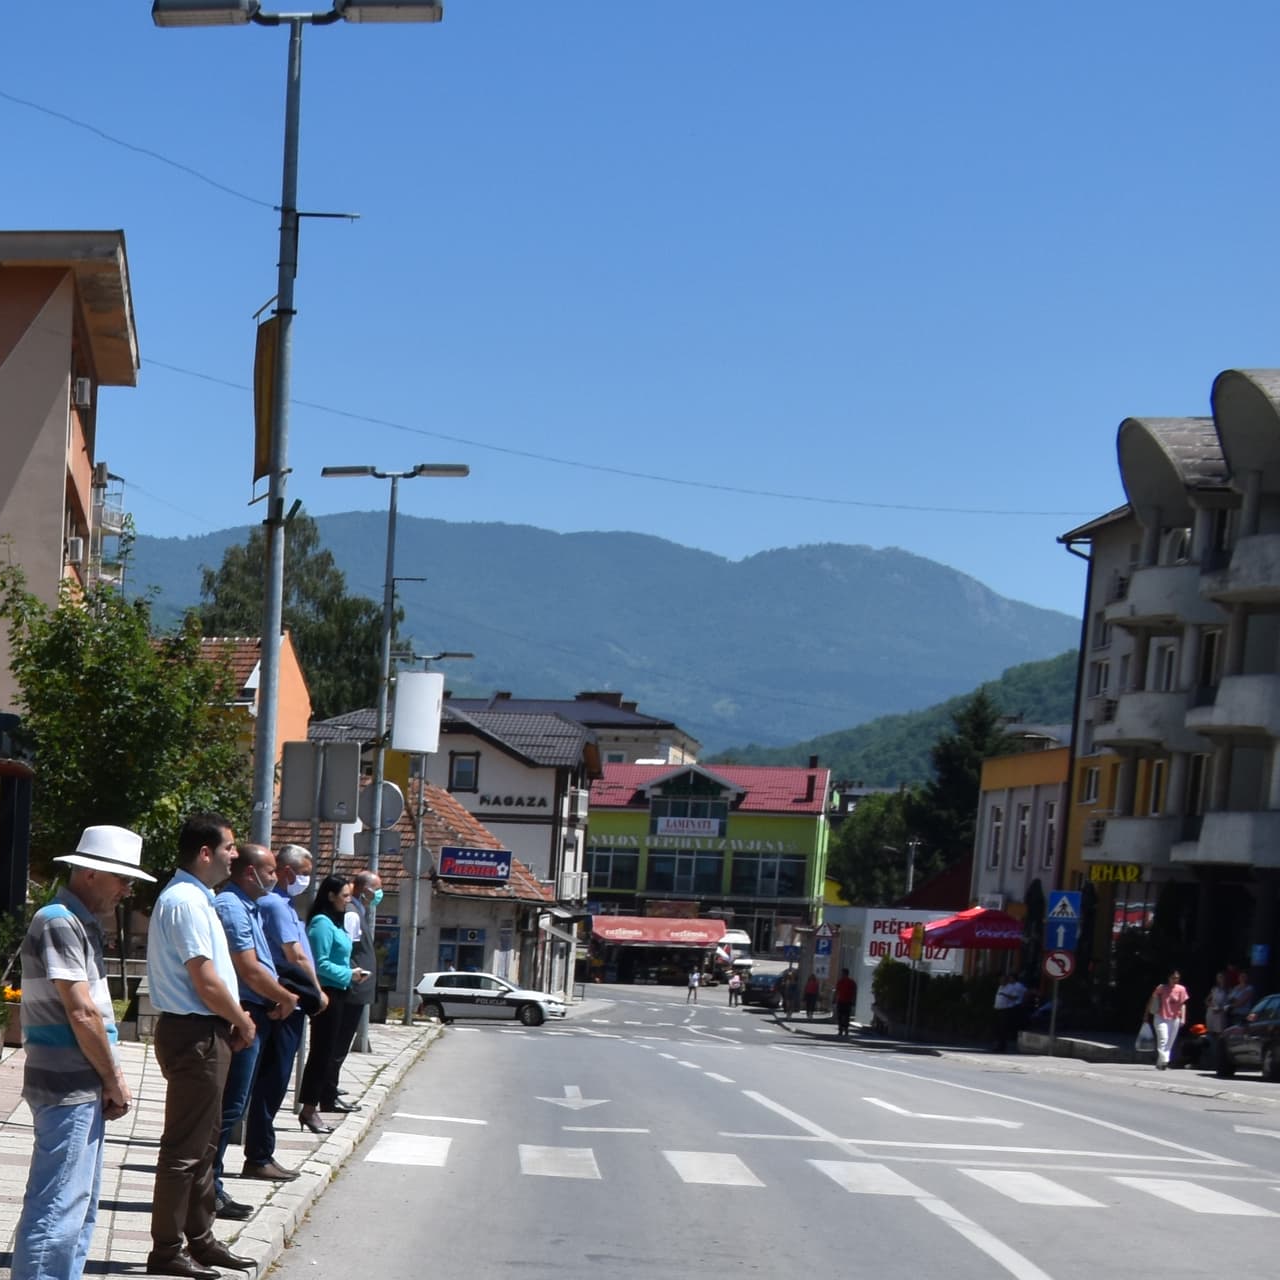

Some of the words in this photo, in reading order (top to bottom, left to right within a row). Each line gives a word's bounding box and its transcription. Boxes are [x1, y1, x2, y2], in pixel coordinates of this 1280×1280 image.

[479, 795, 548, 807] MAGAZA
[666, 818, 711, 829] LAMINATI
[591, 835, 639, 847] SALON
[869, 940, 891, 957] 061
